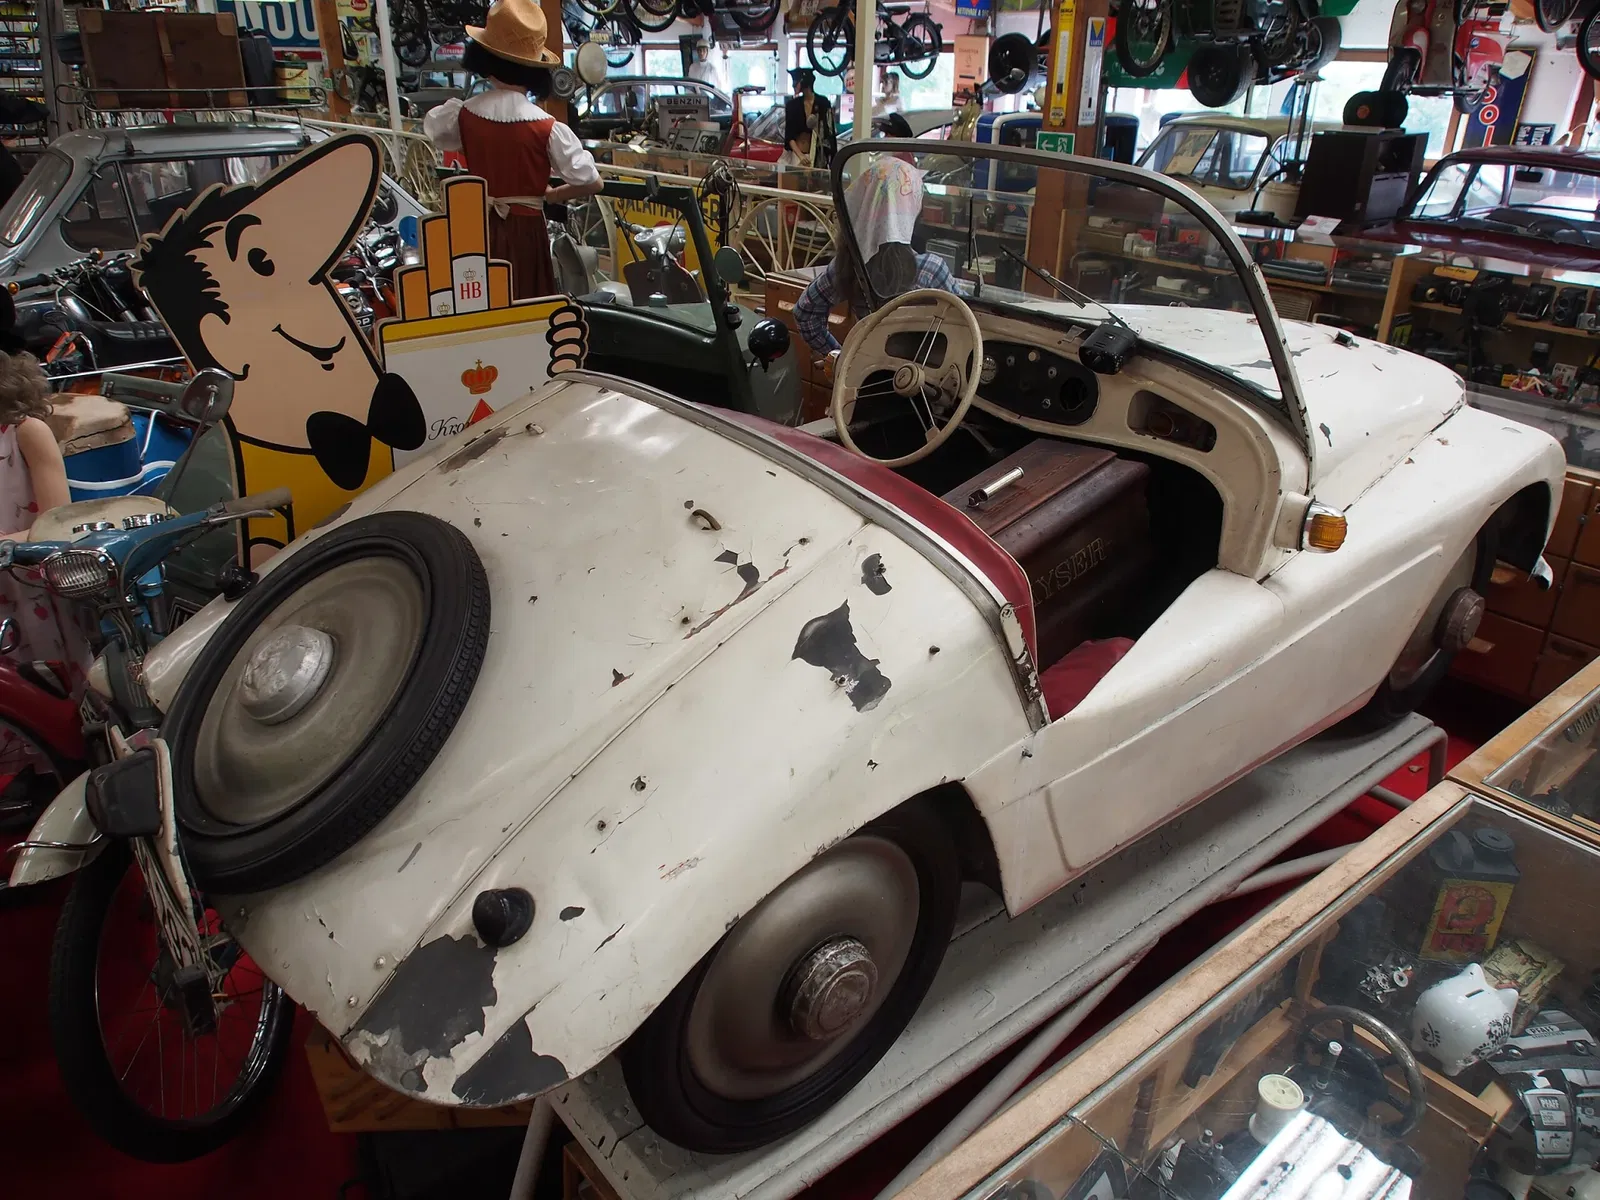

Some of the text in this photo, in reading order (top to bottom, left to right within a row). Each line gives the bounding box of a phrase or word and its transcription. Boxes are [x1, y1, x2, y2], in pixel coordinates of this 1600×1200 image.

[460, 281, 482, 300] HB
[428, 416, 469, 441] Kro
[1034, 537, 1107, 607] YSER
[1529, 1026, 1555, 1035] PFAFF
